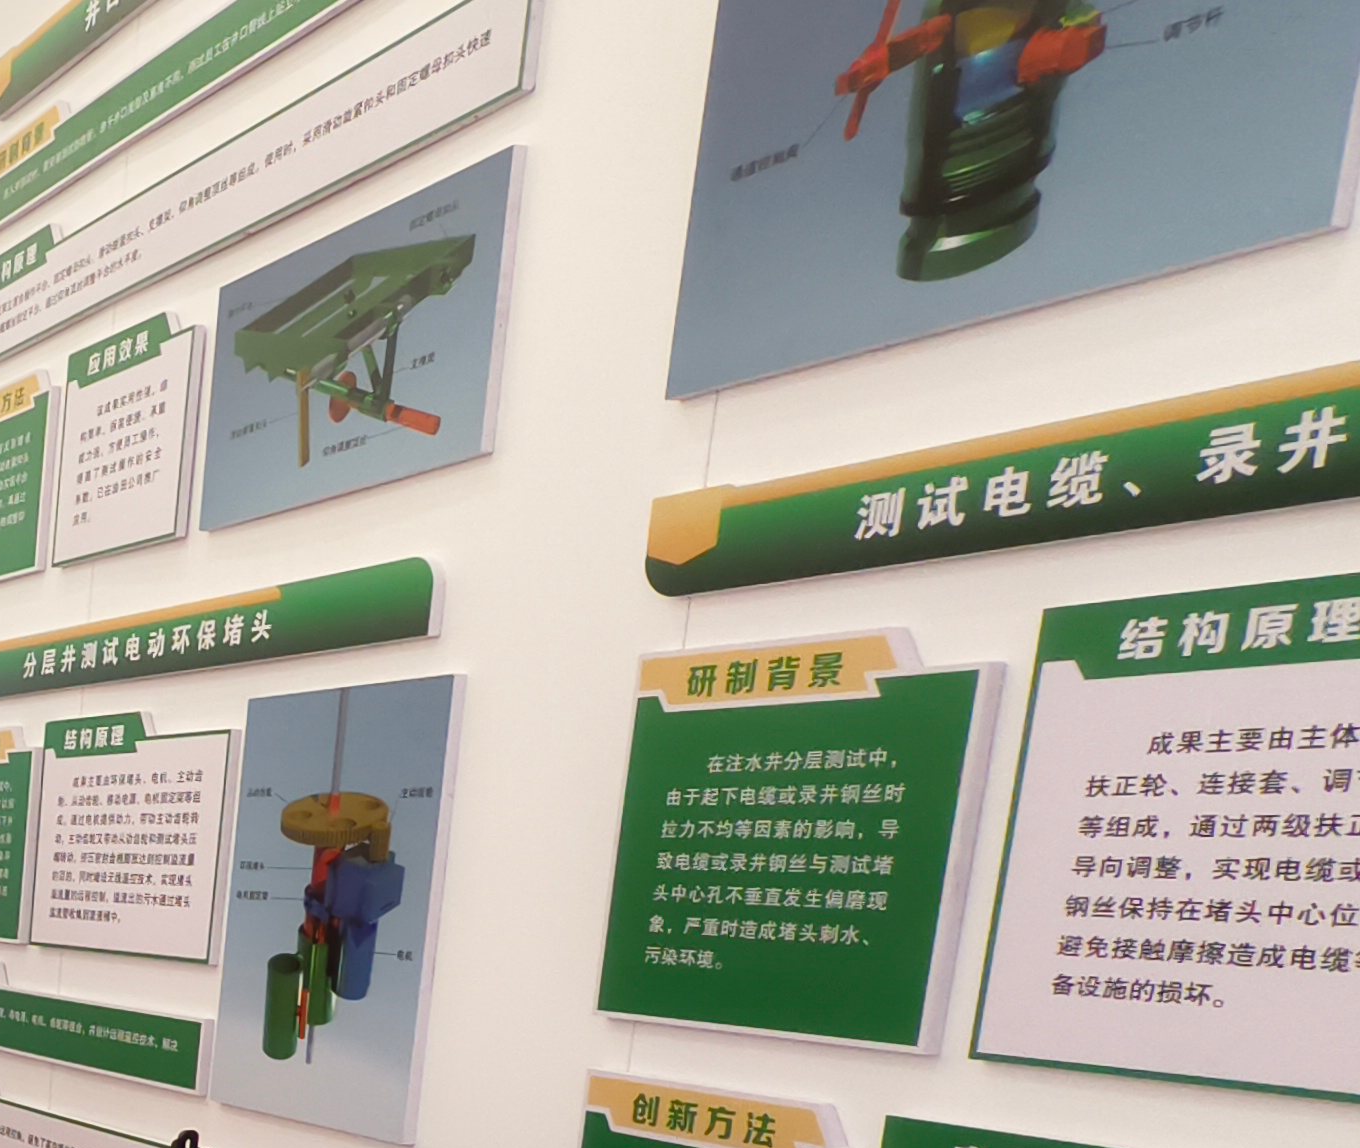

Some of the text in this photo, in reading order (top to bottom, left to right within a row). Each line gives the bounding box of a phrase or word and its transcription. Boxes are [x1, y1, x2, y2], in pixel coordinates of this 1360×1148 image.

[87, 331, 149, 376] 应用效果
[854, 406, 1348, 541] 测试电缆、录井
[23, 609, 273, 679] 分层井测试电动环保堵头
[1116, 596, 1360, 661] 结构原理
[686, 651, 844, 698] 研制背景
[64, 725, 126, 751] 结构原理
[1146, 723, 1360, 756] 成果主要由主体
[706, 748, 899, 774] 在注水井分层测试中，
[665, 782, 907, 807] 由于起下电缆或录井钢丝时
[1084, 768, 1360, 798] 扶正轮、连接套、调
[660, 819, 900, 841] 拉力不均等因素的影响，导
[655, 852, 895, 876] 致电缆或录井钢丝与测试堵
[652, 884, 889, 912] 头中心孔不垂直发生偏磨现
[1064, 894, 1359, 927] 钢丝保持在堵头中心位
[644, 945, 724, 970] 污染环境。
[1056, 934, 1360, 972] 避免接触摩擦造成电缆
[1050, 973, 1225, 1009] 备设施的损坏。
[632, 1093, 776, 1148] 创新方法
